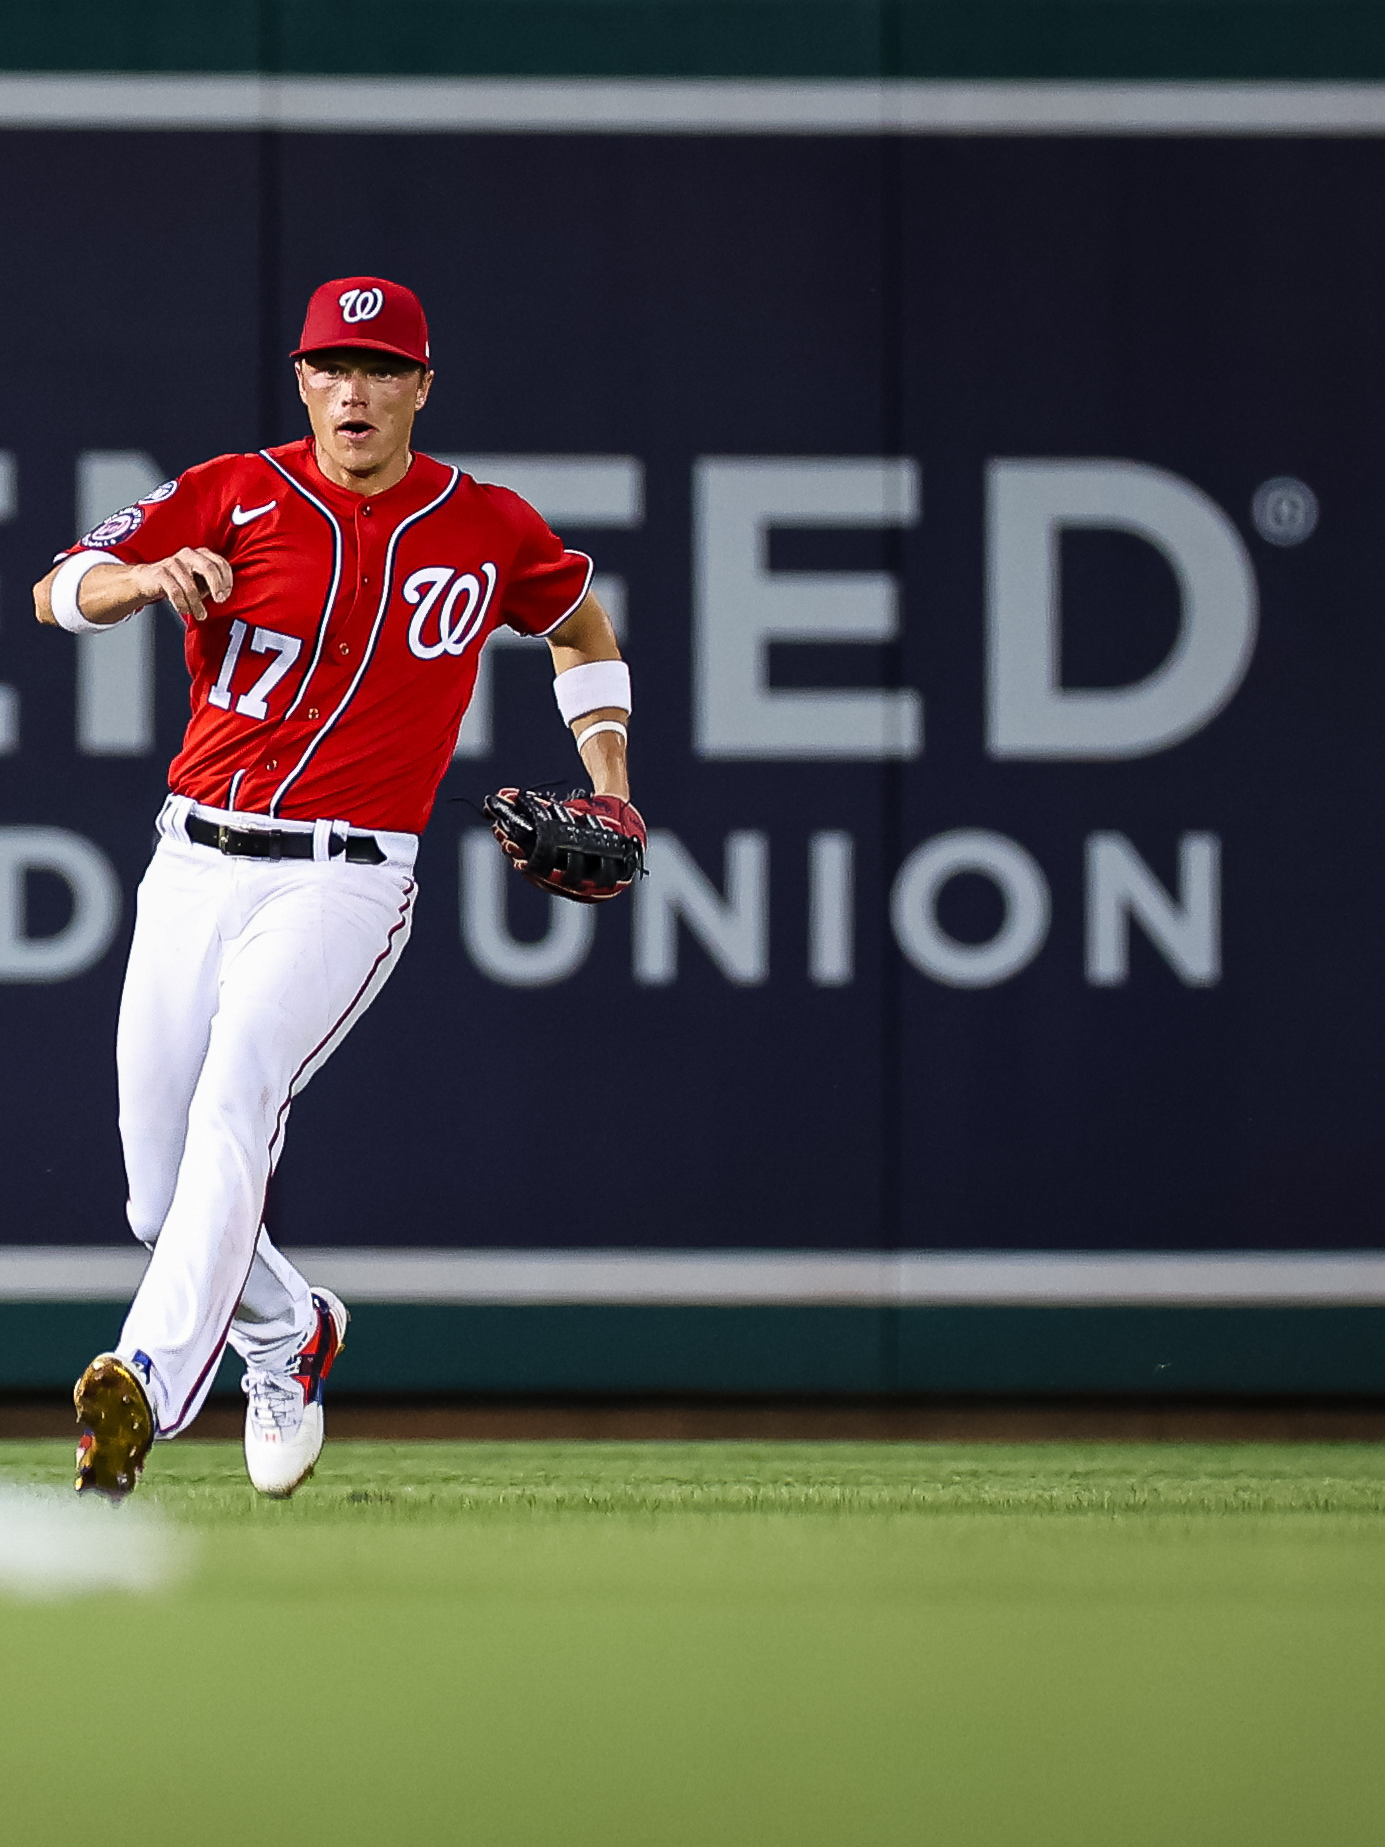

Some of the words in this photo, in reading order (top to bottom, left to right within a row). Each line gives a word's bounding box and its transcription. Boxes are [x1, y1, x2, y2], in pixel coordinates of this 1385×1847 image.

[338, 287, 384, 324] W
[403, 562, 497, 660] W
[207, 619, 302, 720] 17
[461, 829, 1223, 988] UNION
